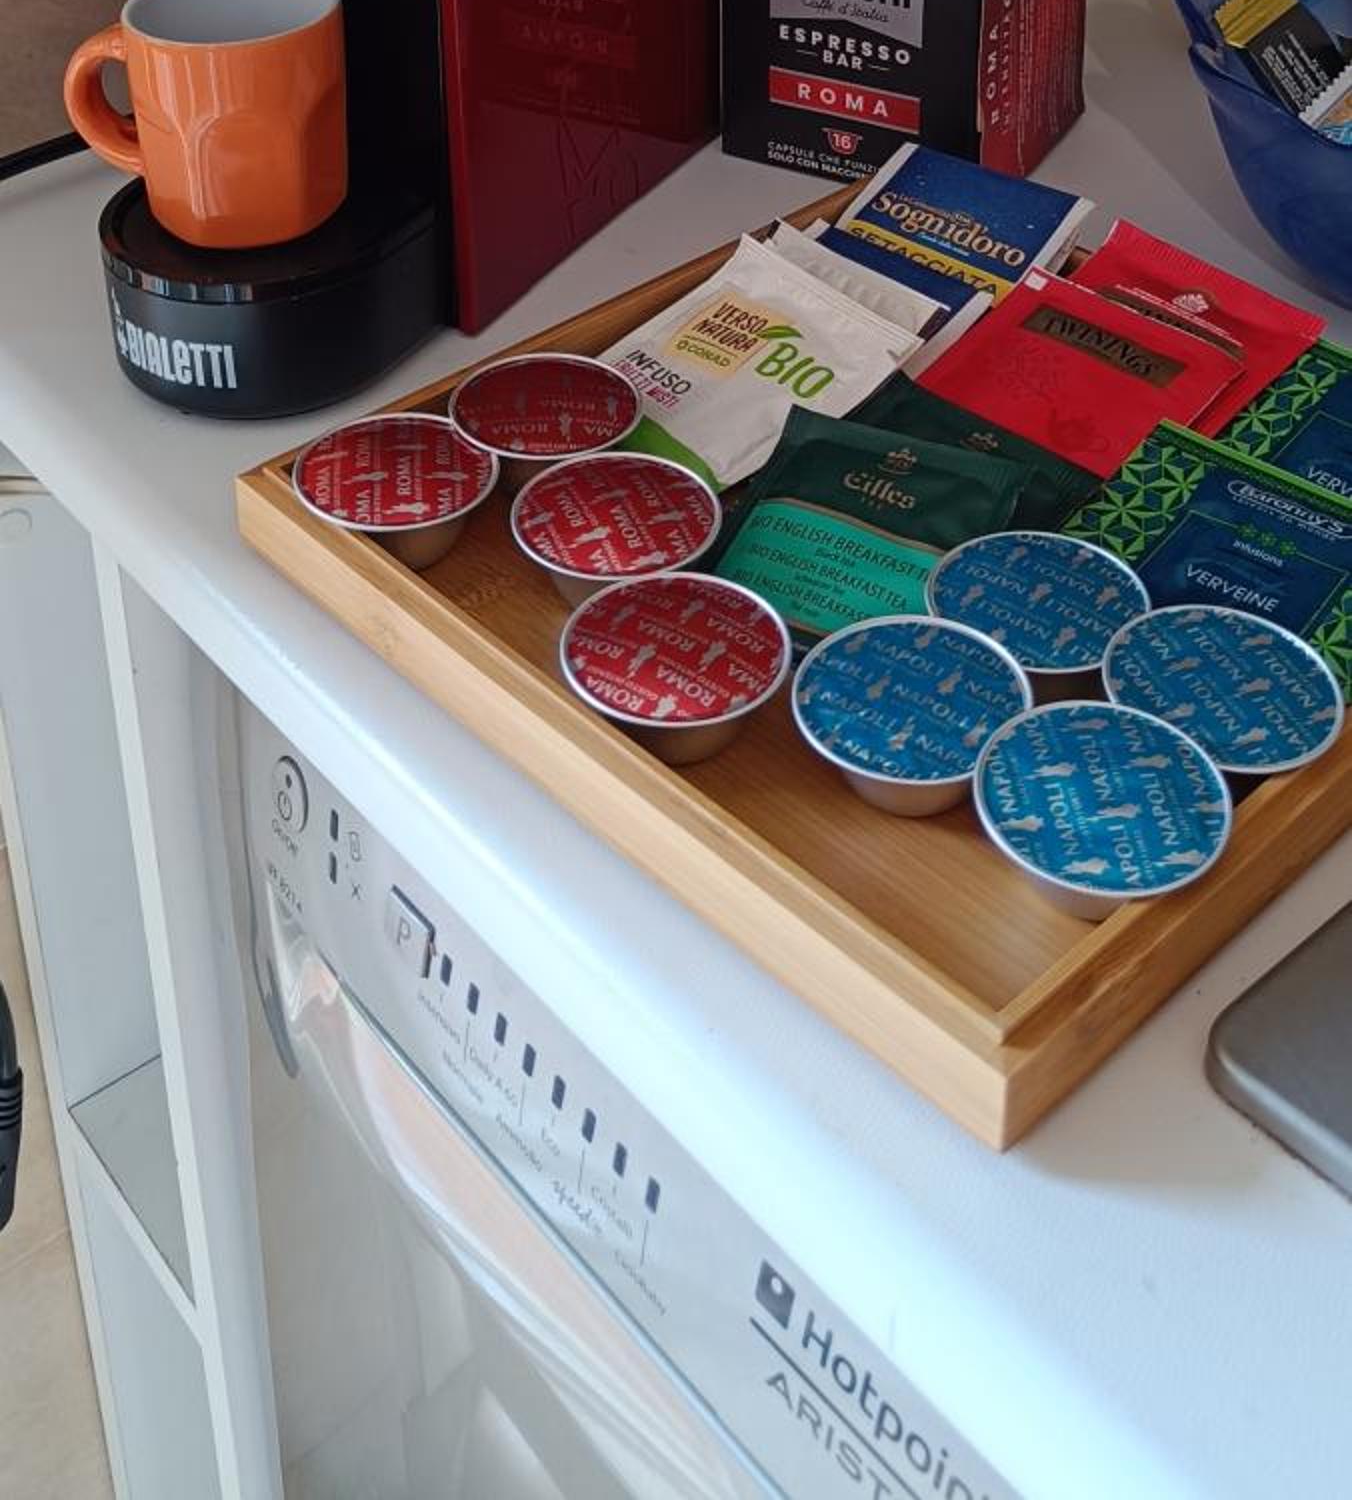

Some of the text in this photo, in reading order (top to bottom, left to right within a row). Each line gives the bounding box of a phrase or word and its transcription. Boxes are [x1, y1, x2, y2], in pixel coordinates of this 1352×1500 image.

[779, 24, 911, 65] ESPRESSO
[823, 50, 863, 70] BAR
[985, 23, 999, 124] ROMA
[797, 83, 889, 117] ROMA
[767, 141, 815, 158] CAPSULE
[818, 153, 840, 166] CHE
[767, 150, 795, 163] SOLO
[797, 157, 820, 170] CON
[831, 133, 852, 149] 16
[691, 318, 758, 352] NATURA
[712, 302, 769, 335] VERSO
[686, 345, 731, 367] CONAD
[1047, 315, 1153, 376] TWININGS
[625, 349, 692, 395] INFUSO
[755, 341, 836, 399] BIO
[315, 465, 330, 506] ROMA
[395, 454, 412, 496] ROMA
[355, 489, 371, 523] OMA
[558, 491, 586, 528] ROMA
[609, 503, 644, 550] ROMA
[773, 516, 834, 544] ENGLISH
[835, 536, 917, 576] BREAKFAST
[753, 572, 801, 598] ENGLISH
[769, 550, 818, 572] ENGLISH
[819, 564, 885, 598] BREAKFAST
[886, 590, 908, 610] TEA
[959, 563, 1026, 595] NAPOLI
[1021, 559, 1096, 595] NAPOLI
[1186, 563, 1280, 613] VERVEINE
[640, 618, 697, 652] ROMA
[707, 615, 768, 654] ROMA
[975, 600, 1051, 640] NAPOLI
[870, 639, 945, 677] NAPOLI
[1186, 627, 1245, 681] NAPOLI
[585, 674, 644, 711] ROMA
[656, 664, 718, 708] ROMA
[1256, 648, 1317, 709] NAPOLI
[819, 690, 900, 731] NAPOLI
[891, 683, 971, 729] NAPOLI
[1182, 672, 1242, 733] NAPOLI
[1077, 733, 1115, 802] NAPOLI
[1043, 782, 1080, 856] NAPOLI
[1140, 772, 1181, 847] NAPOLI
[1107, 823, 1145, 886] APOLI
[395, 915, 412, 946] P
[801, 1309, 990, 1500] Hotpoin
